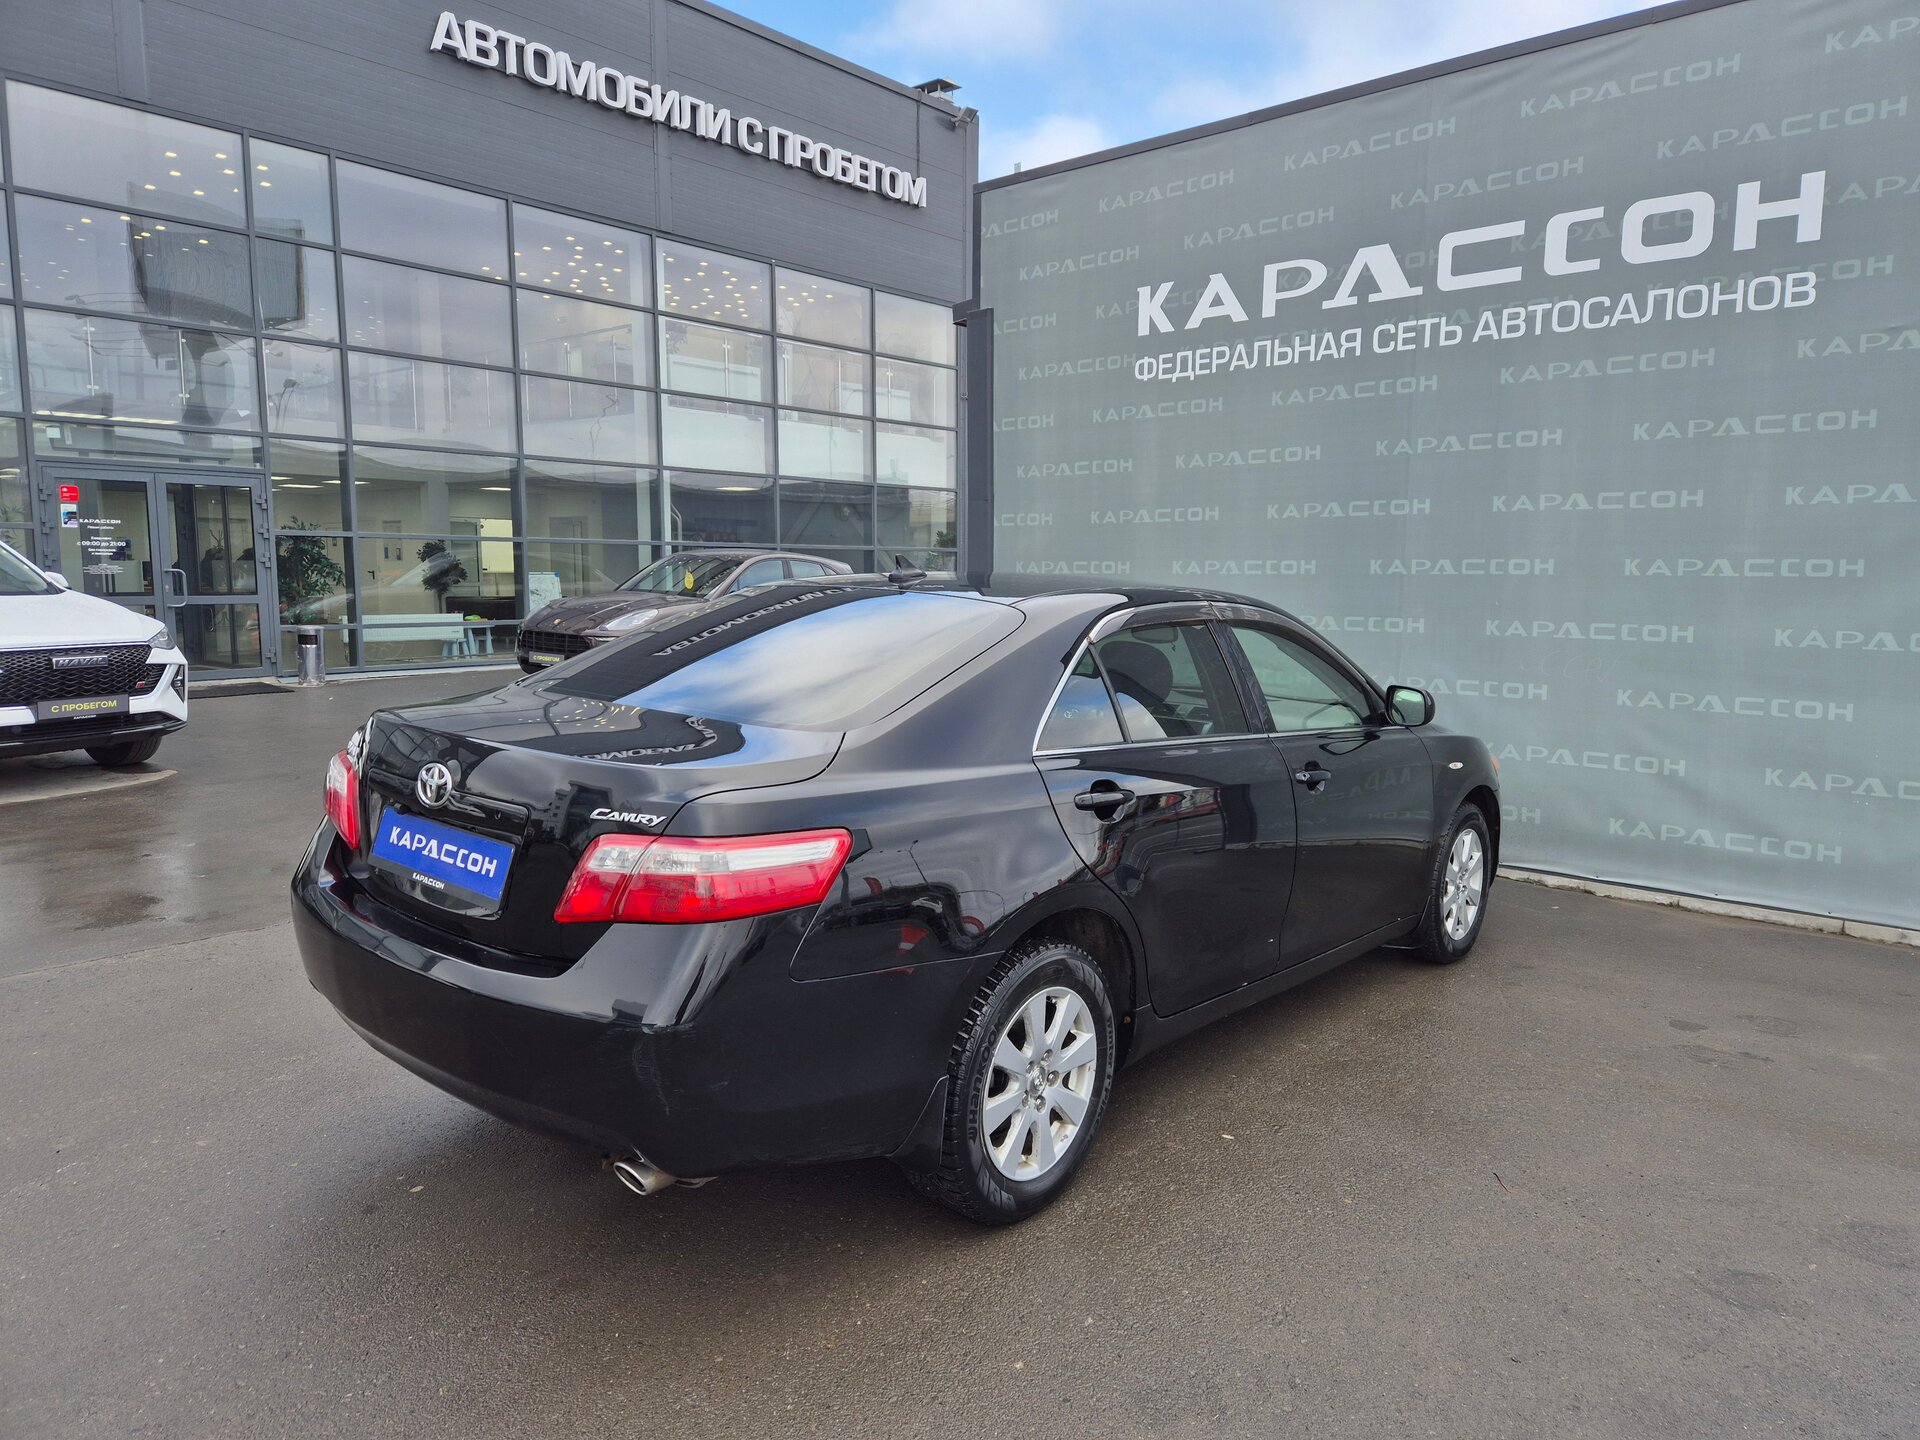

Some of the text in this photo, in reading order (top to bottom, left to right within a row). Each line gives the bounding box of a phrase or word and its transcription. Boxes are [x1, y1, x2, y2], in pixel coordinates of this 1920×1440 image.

[1824, 16, 1920, 54] КАР
[1519, 53, 1742, 118] КАРАССОН
[430, 11, 927, 208] АВТОМОБИЛИ С ПРОБЕГОМ
[1283, 116, 1456, 171] КАРАССОН
[1656, 96, 1908, 160] КАРАССОН
[1099, 169, 1235, 213] КАРАССОН
[1390, 156, 1584, 210] КАРАССОН
[1184, 205, 1335, 250] КАРАССОН
[1019, 246, 1140, 281] КАРАССОН
[1137, 170, 1826, 337] КАРАССОН
[1134, 328, 1362, 383] ФЕДЕРАЛЬНАЯ
[1372, 317, 1463, 354] СЕТЬ
[1472, 271, 1817, 343] АВТОСАЛОНОВ
[1018, 353, 1137, 381] КАРАССОН
[1500, 347, 1715, 384] КАРАССОН
[1271, 375, 1438, 406] КАРАССОН
[1093, 397, 1223, 423] КАРАССОН
[1633, 408, 1877, 441] КАРАССОН
[1175, 445, 1321, 469] КАРАССОН
[1376, 429, 1562, 456] КАРАССОН
[1017, 458, 1132, 478] КАРАССОН
[1091, 506, 1219, 524] КАРАССОН
[1267, 498, 1431, 519] КАРАССОН
[1492, 489, 1704, 512] КАРАССОН
[1016, 560, 1130, 575] КАРАССОН
[1172, 559, 1316, 576] КАРАССОН
[1370, 558, 1555, 575] КАРАССОН
[1624, 558, 1865, 578] КАРАССОН
[1486, 619, 1694, 643] КАРАССОН
[56, 657, 106, 667] HAVAL
[51, 700, 117, 713] С ПРОБЕГОМ
[1617, 689, 1854, 722] КАРАССОН
[389, 826, 498, 878] КАРАССОН
[1609, 818, 1842, 864] КАРАССОН
[412, 872, 444, 890] КАРАССОН
